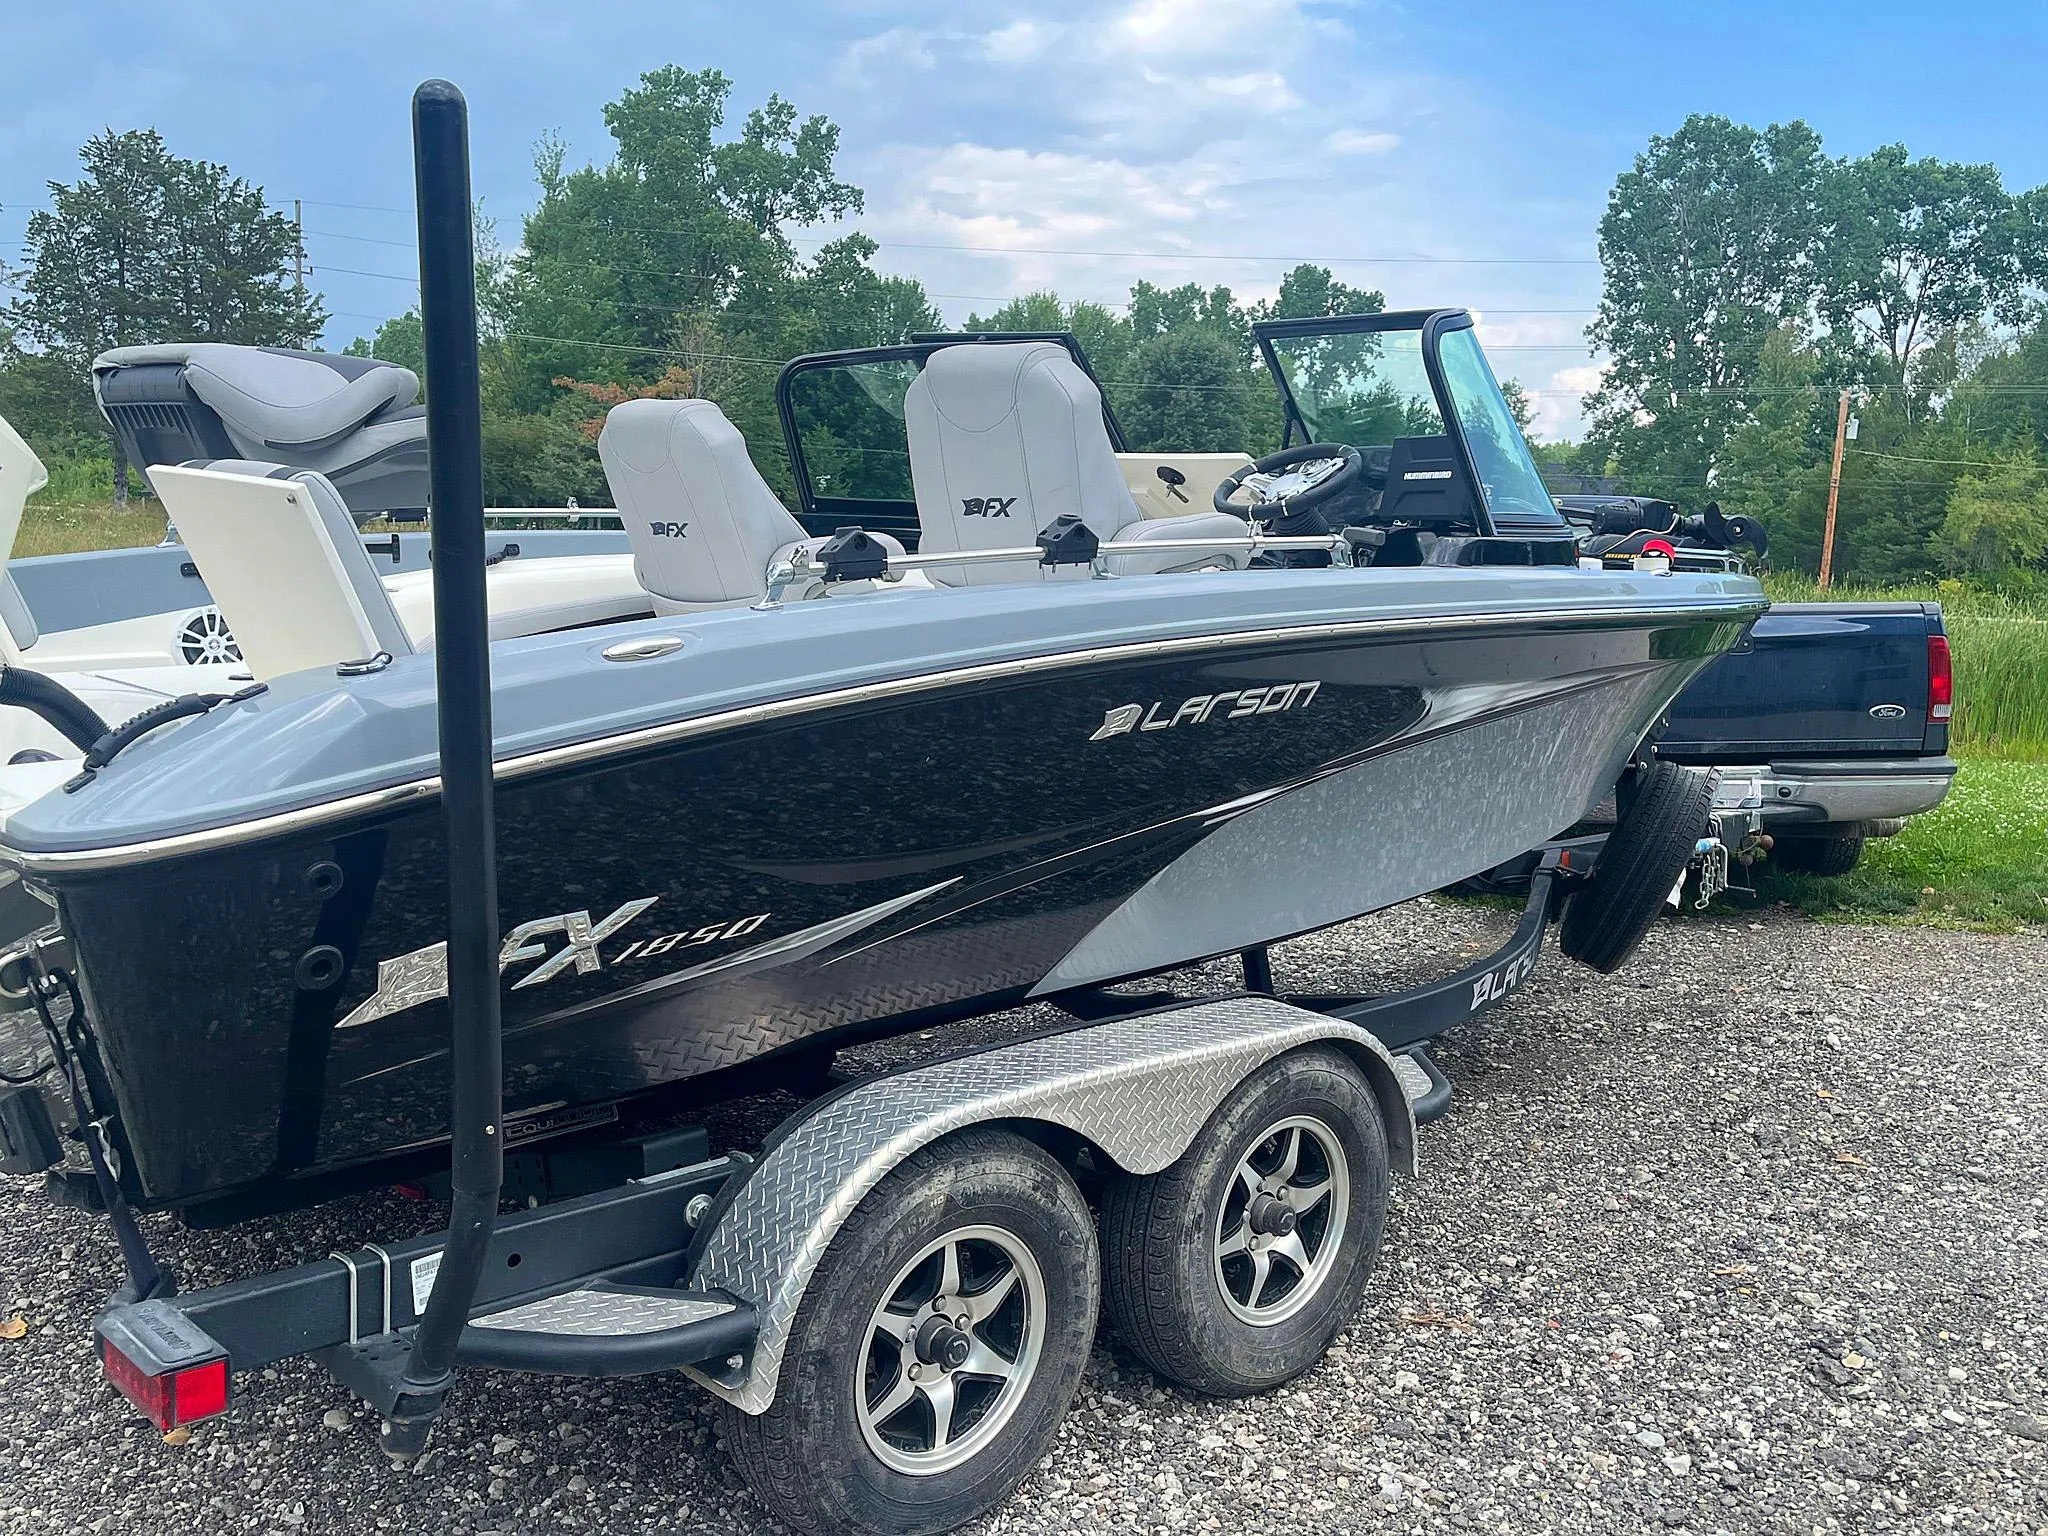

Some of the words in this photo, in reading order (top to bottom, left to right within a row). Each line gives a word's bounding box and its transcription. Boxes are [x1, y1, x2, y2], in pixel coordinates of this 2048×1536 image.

[982, 498, 1018, 517] FX
[666, 523, 688, 537] FX
[1140, 681, 1321, 731] LARSON
[1878, 708, 1898, 718] Ford
[499, 896, 659, 990] FX
[610, 913, 772, 965] 1850
